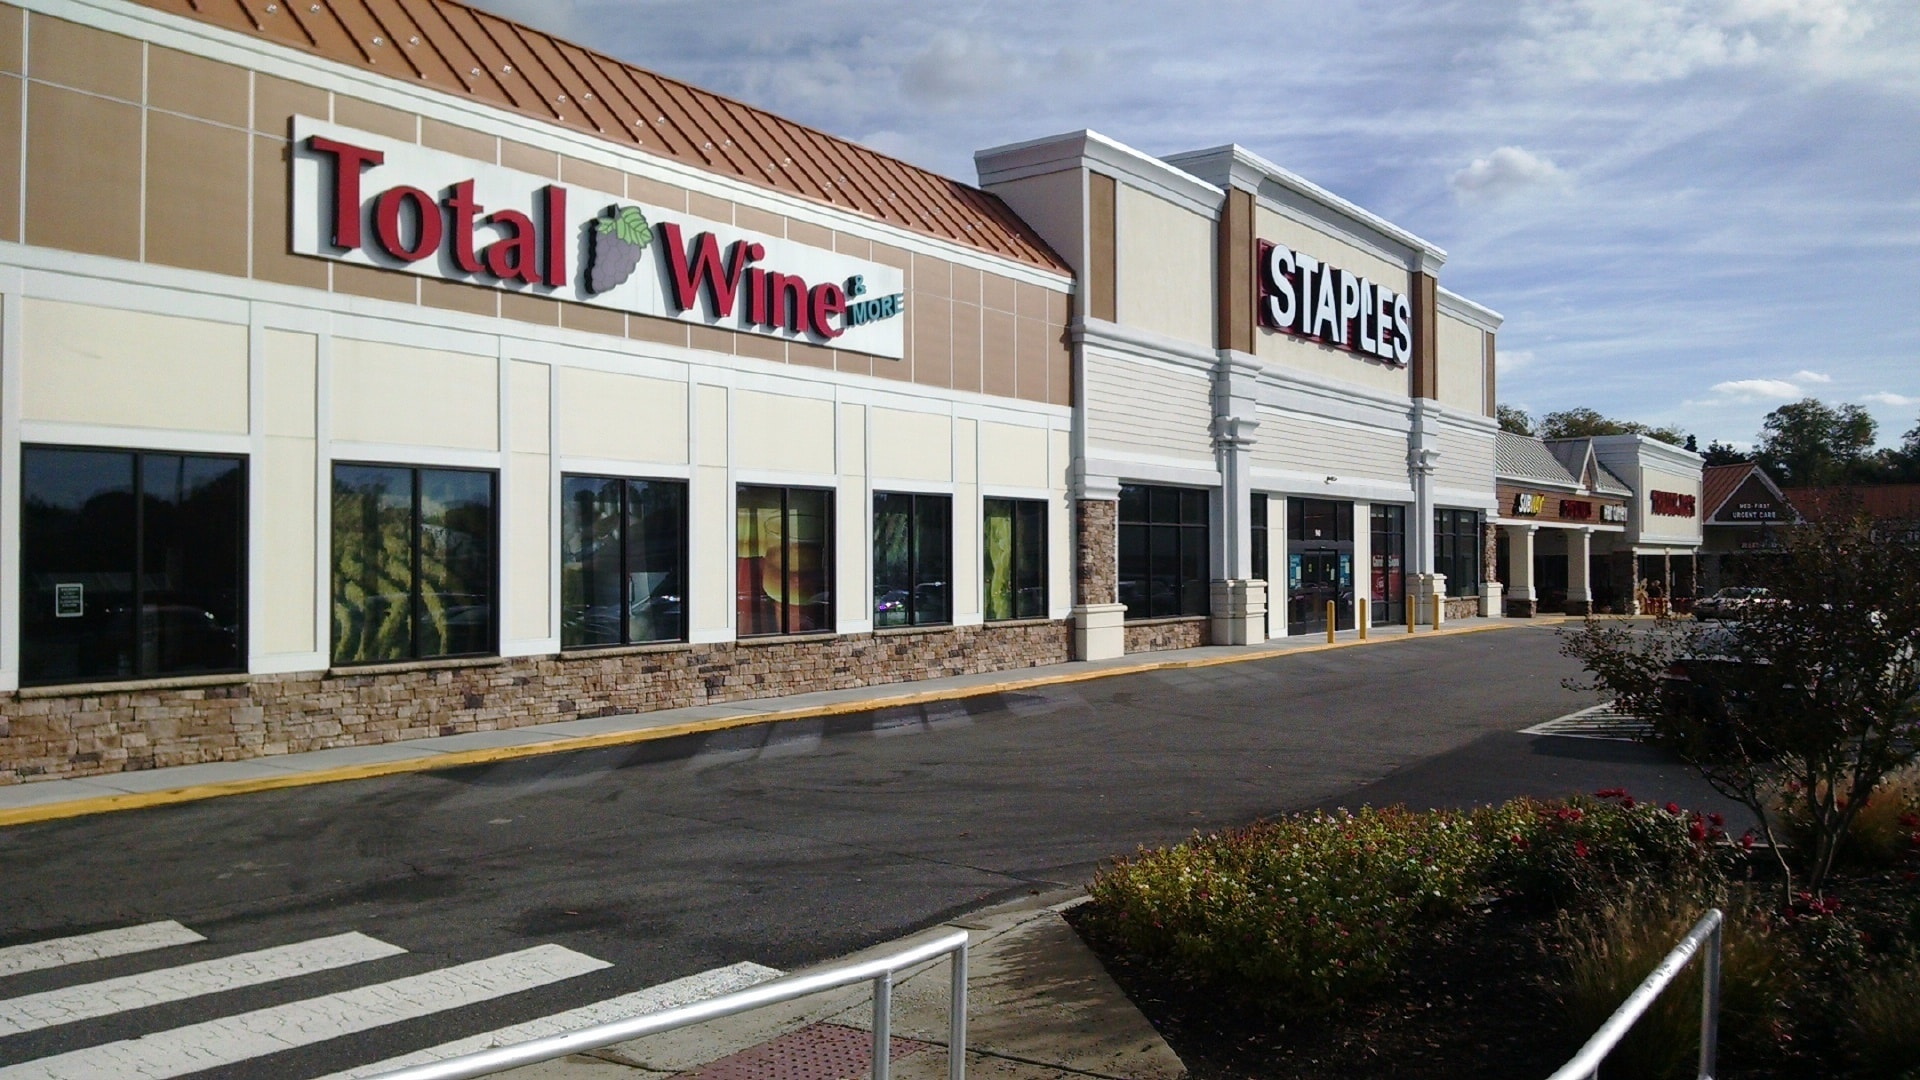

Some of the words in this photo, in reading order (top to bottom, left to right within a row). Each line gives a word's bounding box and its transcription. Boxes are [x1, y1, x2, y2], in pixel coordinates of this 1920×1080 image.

[308, 134, 567, 289] Total
[656, 220, 846, 340] Wine
[851, 292, 904, 325] MORE
[852, 274, 867, 296] &
[1269, 244, 1412, 363] STAPLES
